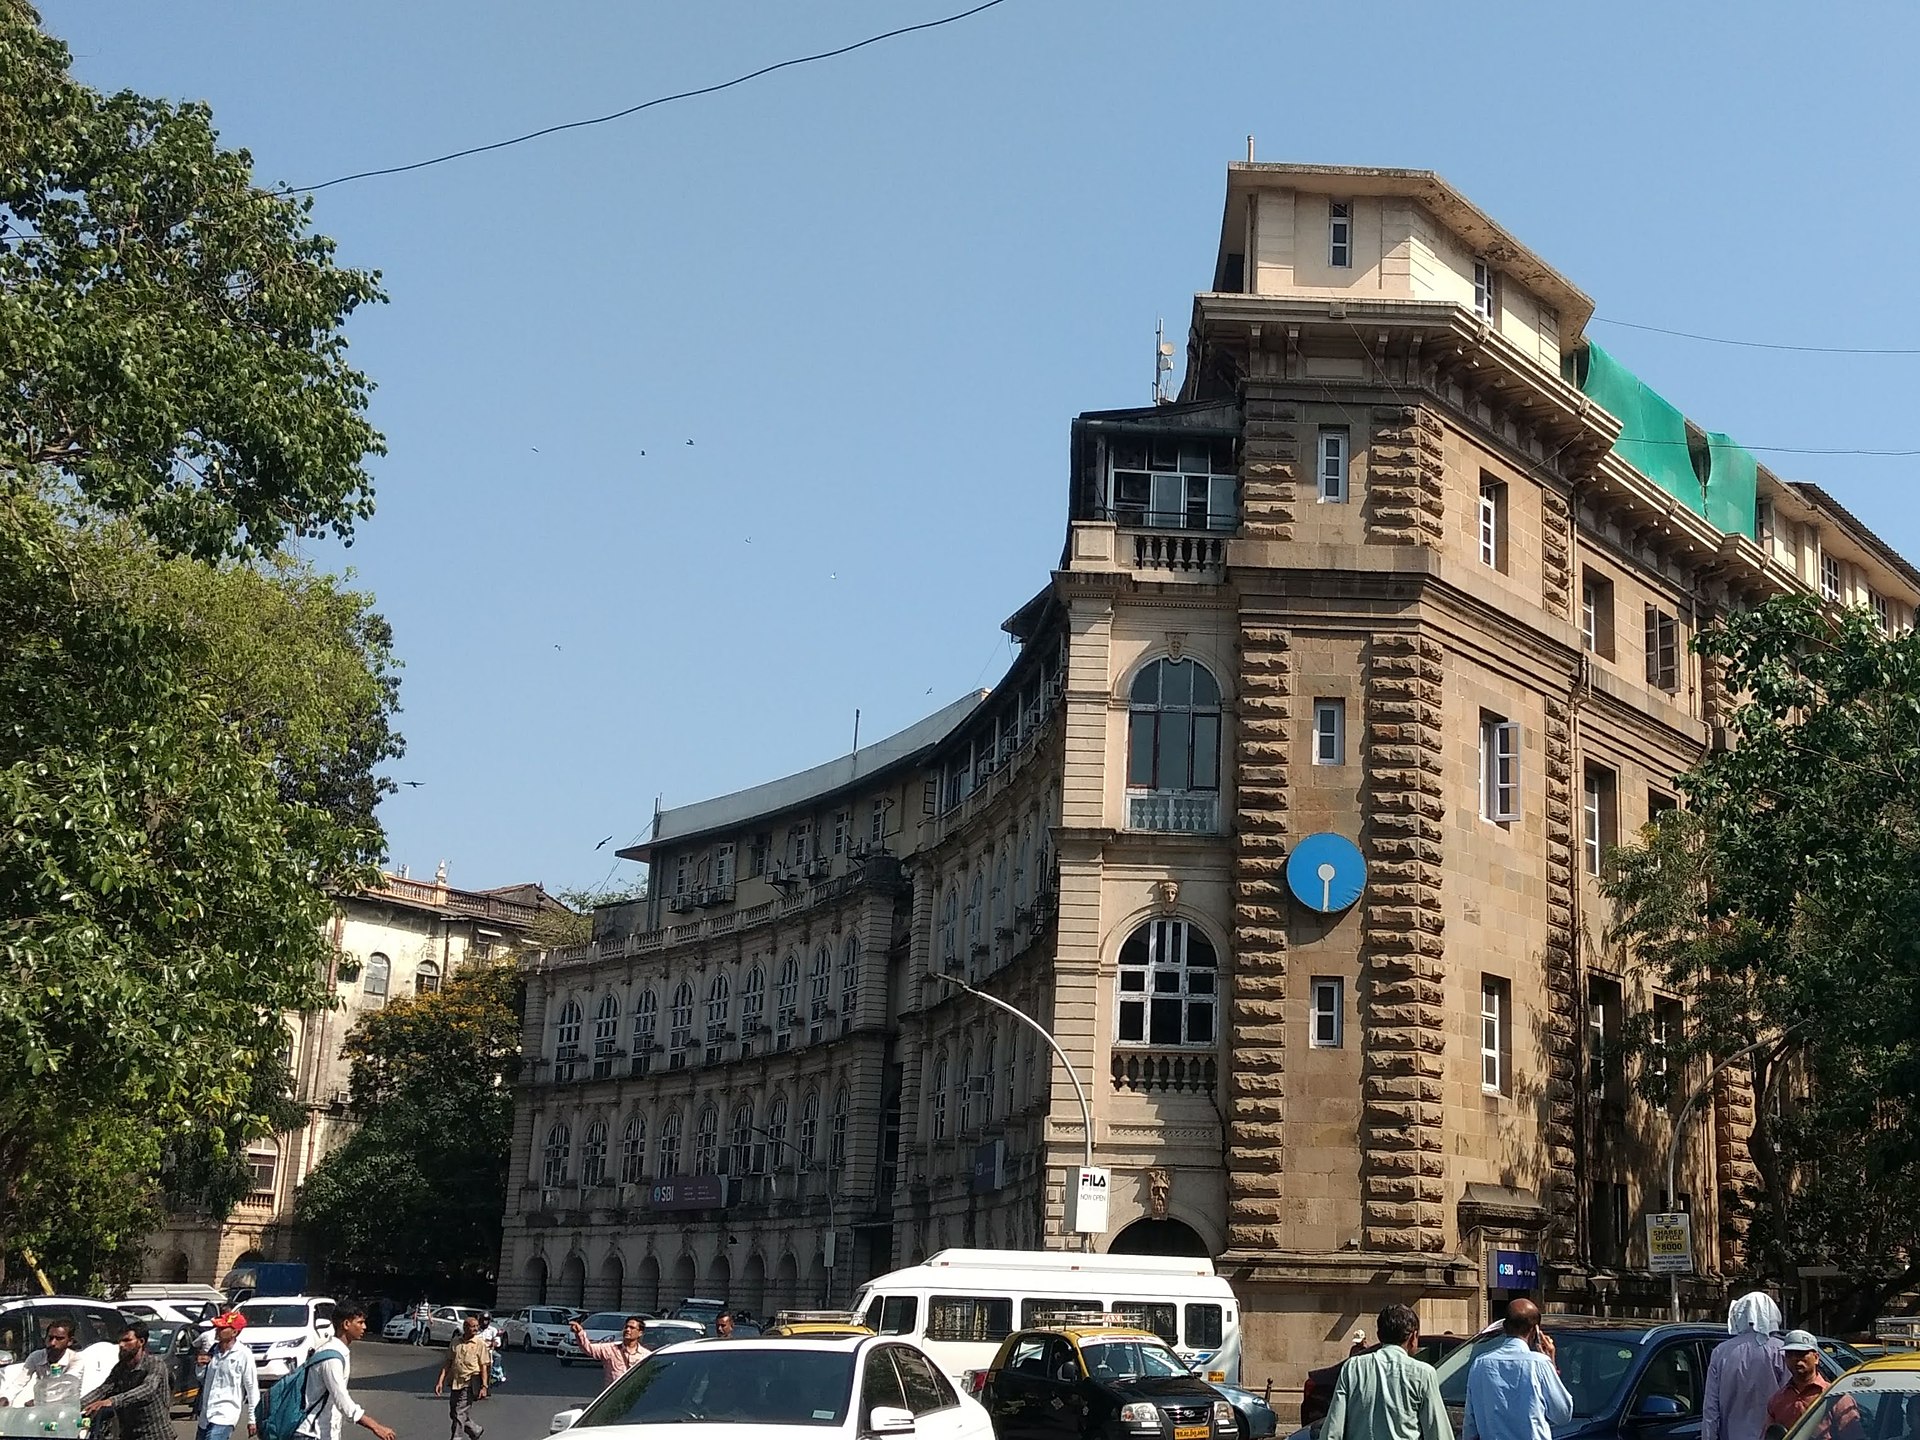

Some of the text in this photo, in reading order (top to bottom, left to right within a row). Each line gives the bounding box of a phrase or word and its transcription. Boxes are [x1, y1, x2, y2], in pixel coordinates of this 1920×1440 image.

[1082, 1174, 1106, 1187] FILA
[661, 1186, 674, 1202] SBI
[1504, 1264, 1514, 1275] SBI
